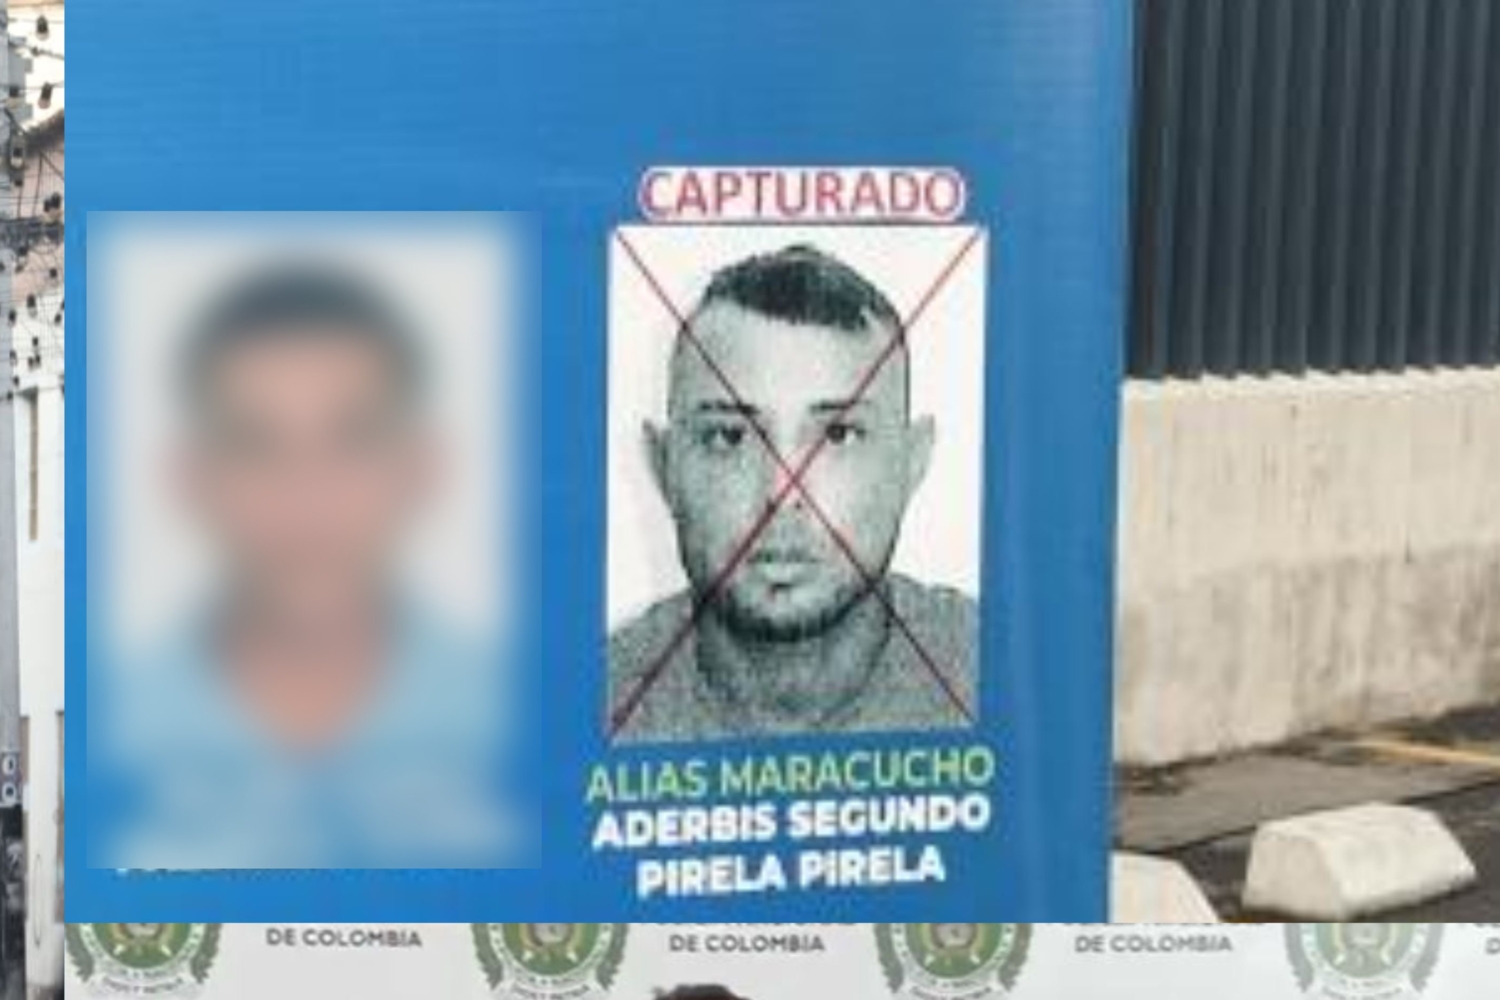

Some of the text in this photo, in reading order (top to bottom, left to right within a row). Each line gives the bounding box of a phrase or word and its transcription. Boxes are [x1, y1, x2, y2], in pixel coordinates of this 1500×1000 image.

[642, 170, 961, 217] CAPTURADO
[586, 746, 995, 802] ALIAS MARACUCHO
[591, 793, 992, 850] ADERBIS SEGUNDO
[636, 844, 945, 899] PIRELA PIRELA
[266, 927, 423, 948] DE COLOMBIA
[669, 933, 826, 952] DE COLOMBIA
[1074, 935, 1232, 953] DE COLOMBIA
